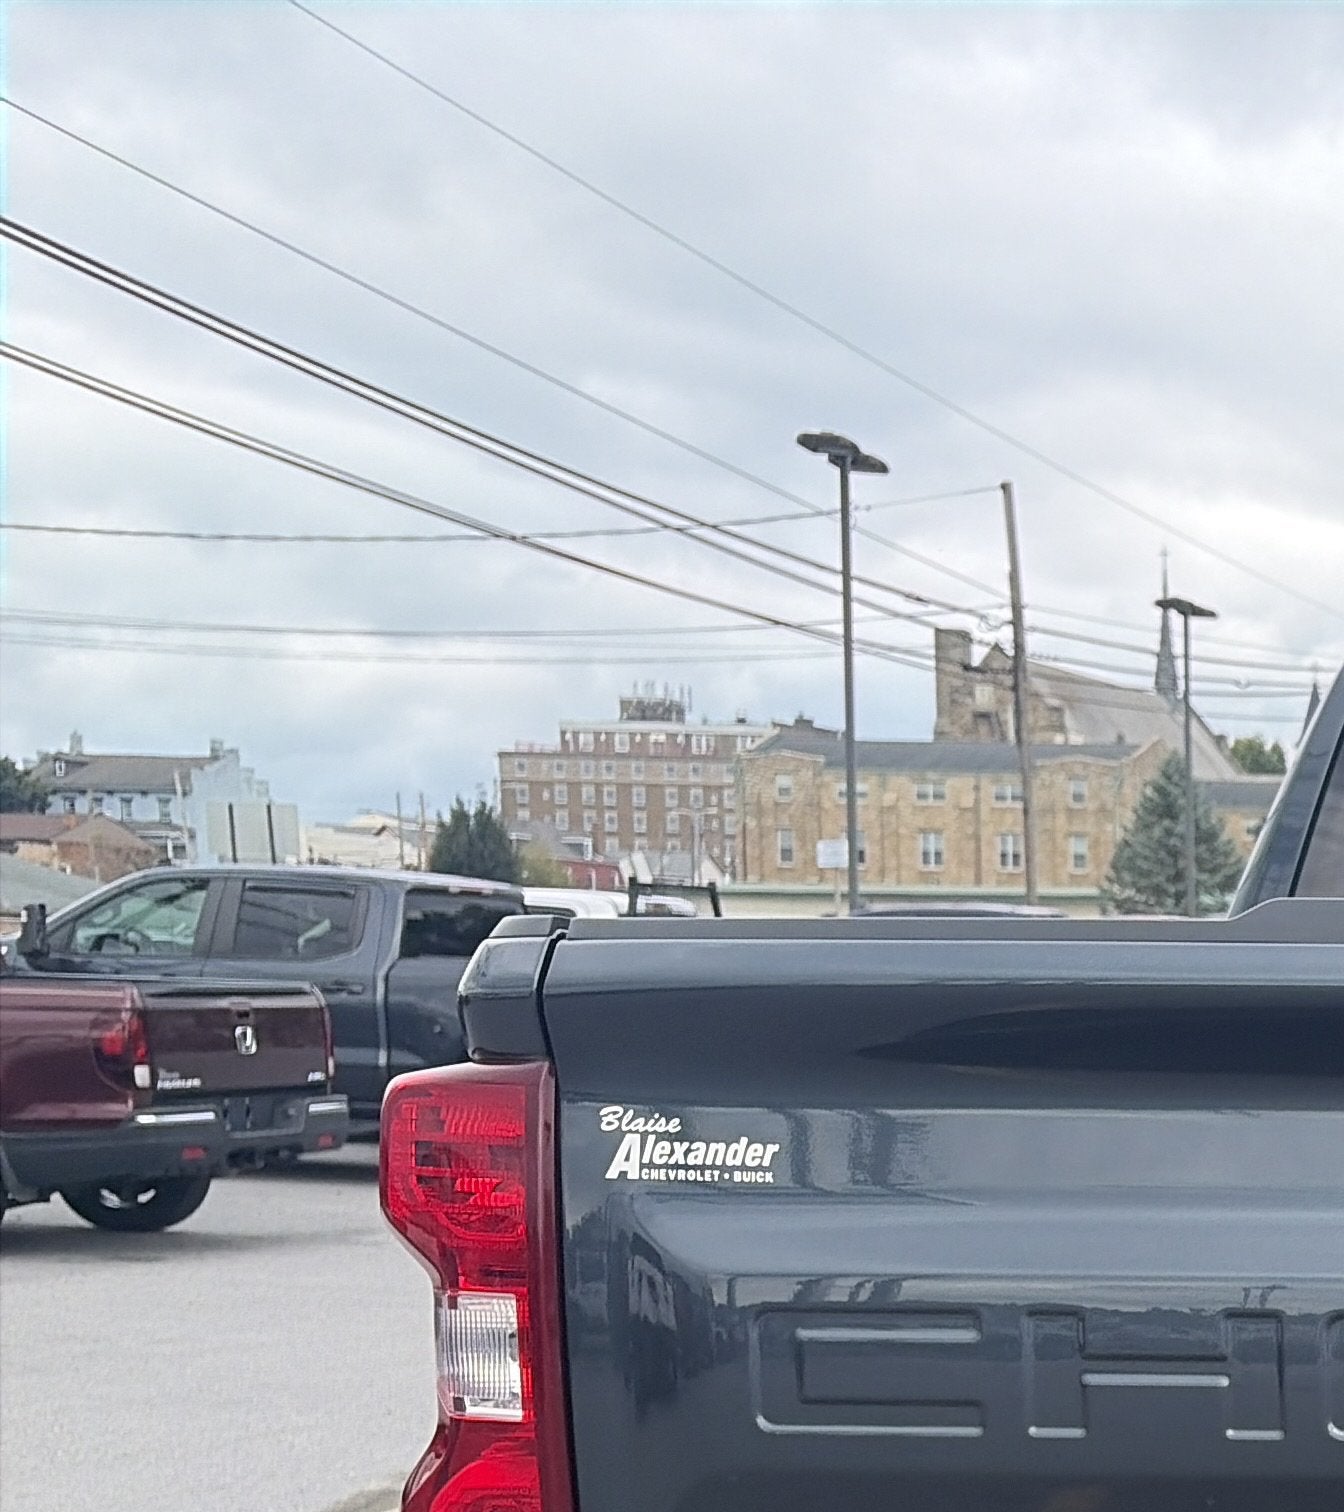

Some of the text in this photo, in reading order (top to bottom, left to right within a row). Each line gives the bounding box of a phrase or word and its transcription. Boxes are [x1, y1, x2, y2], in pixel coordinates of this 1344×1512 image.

[600, 1105, 682, 1133] Blaise
[605, 1133, 780, 1180] Alexander
[641, 1169, 774, 1183] CHEVROLET BUICK
